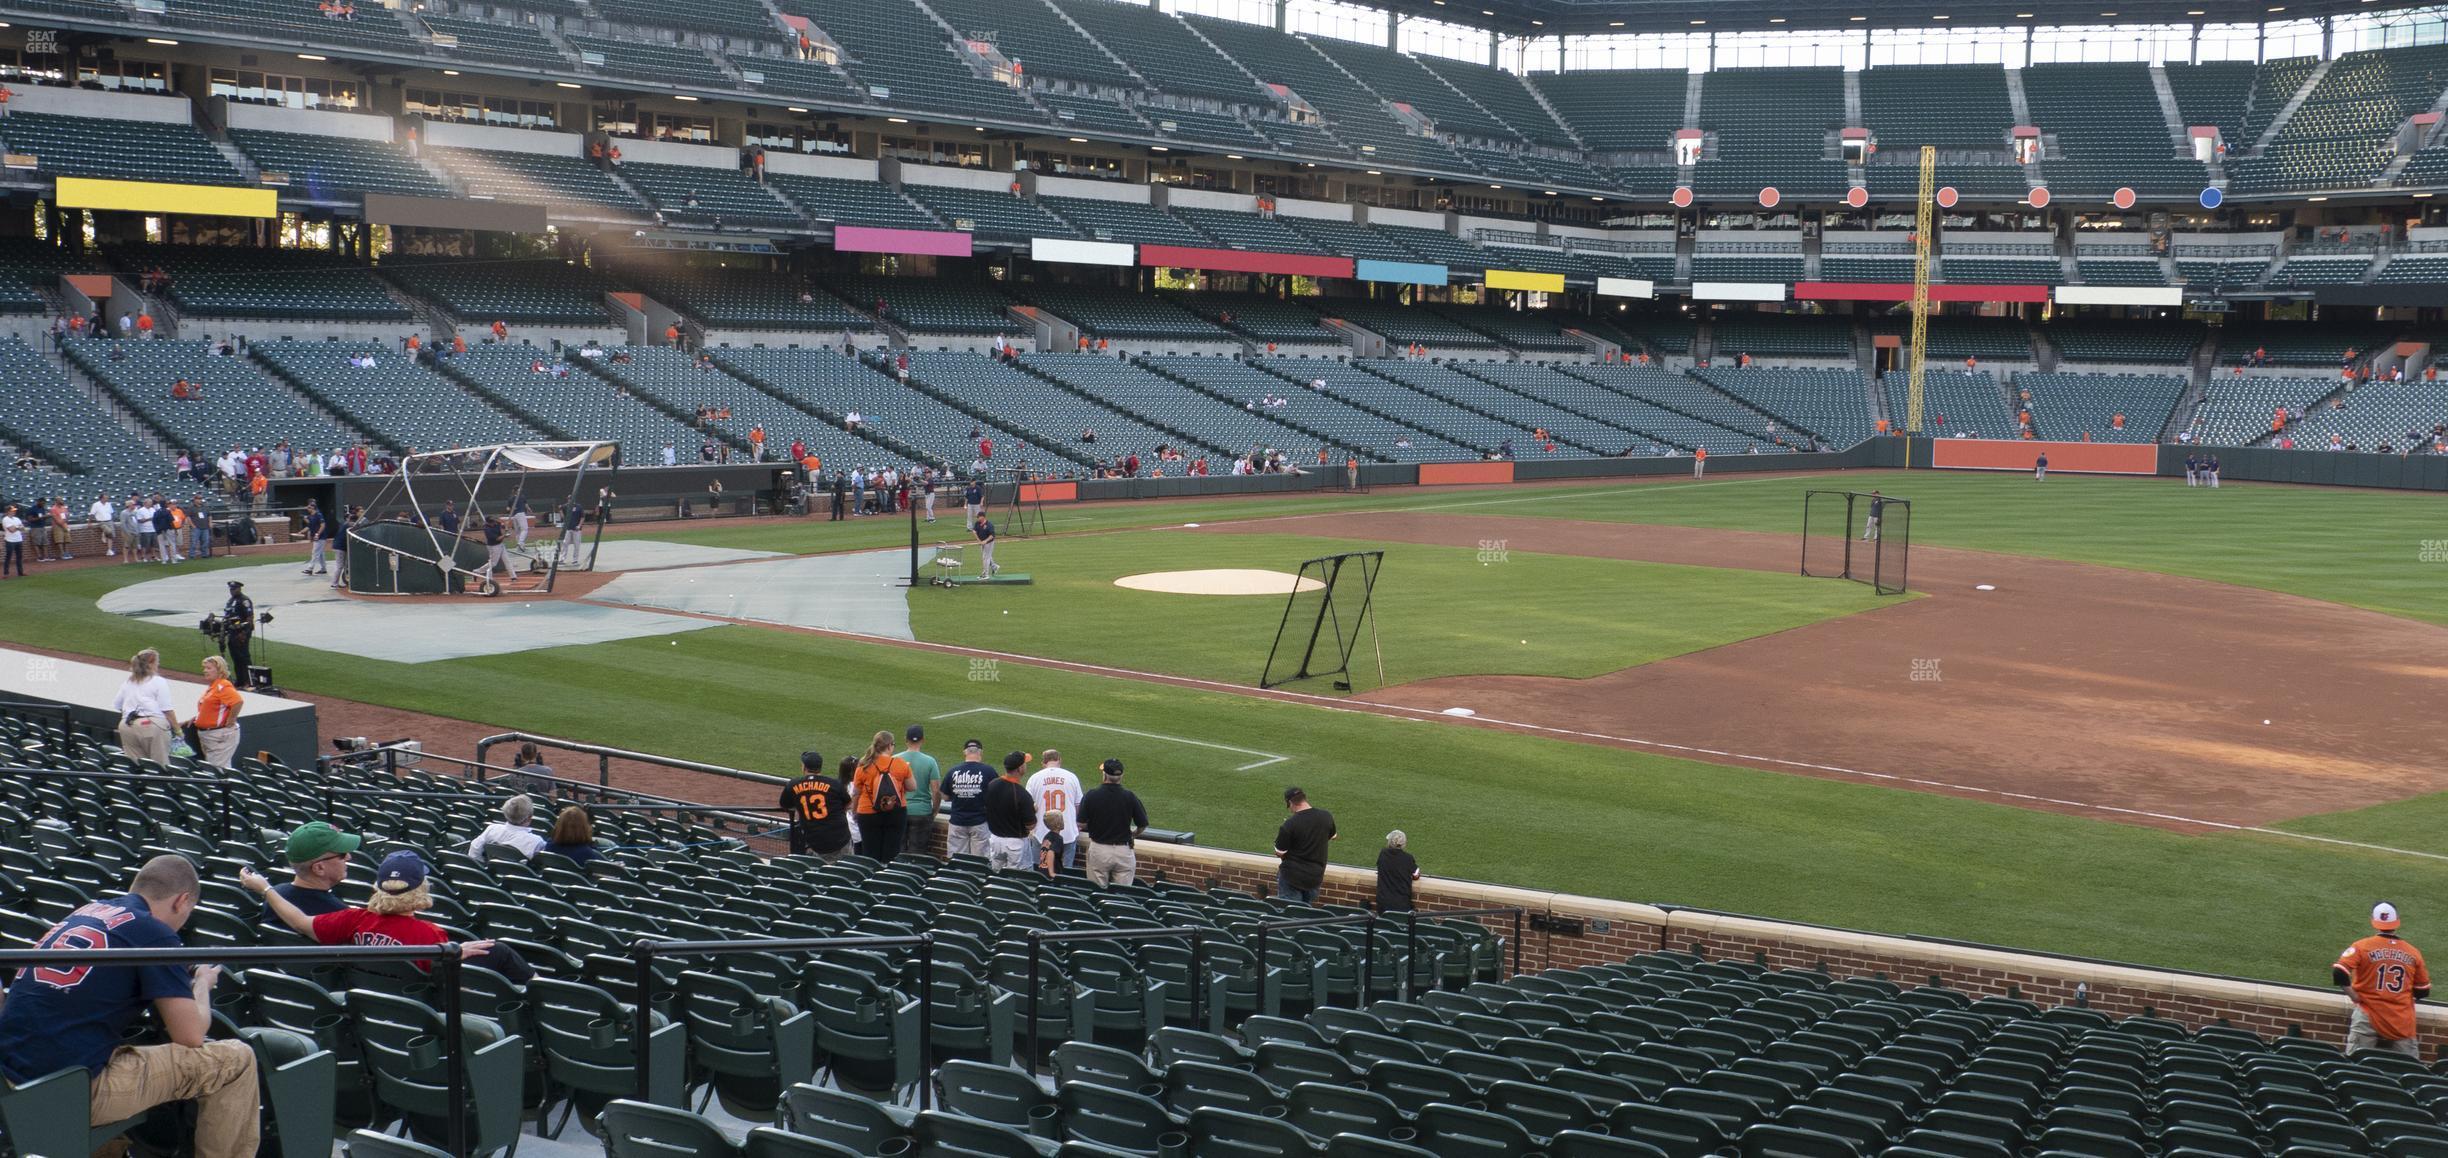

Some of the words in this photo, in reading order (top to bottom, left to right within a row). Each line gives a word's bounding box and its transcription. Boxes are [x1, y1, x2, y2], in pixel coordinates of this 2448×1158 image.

[951, 770, 983, 785] Father's
[1043, 777, 1065, 786] JONES
[792, 781, 831, 795] MACHADO
[800, 793, 828, 820] 13
[1043, 789, 1066, 813] 10
[2376, 964, 2406, 993] 13
